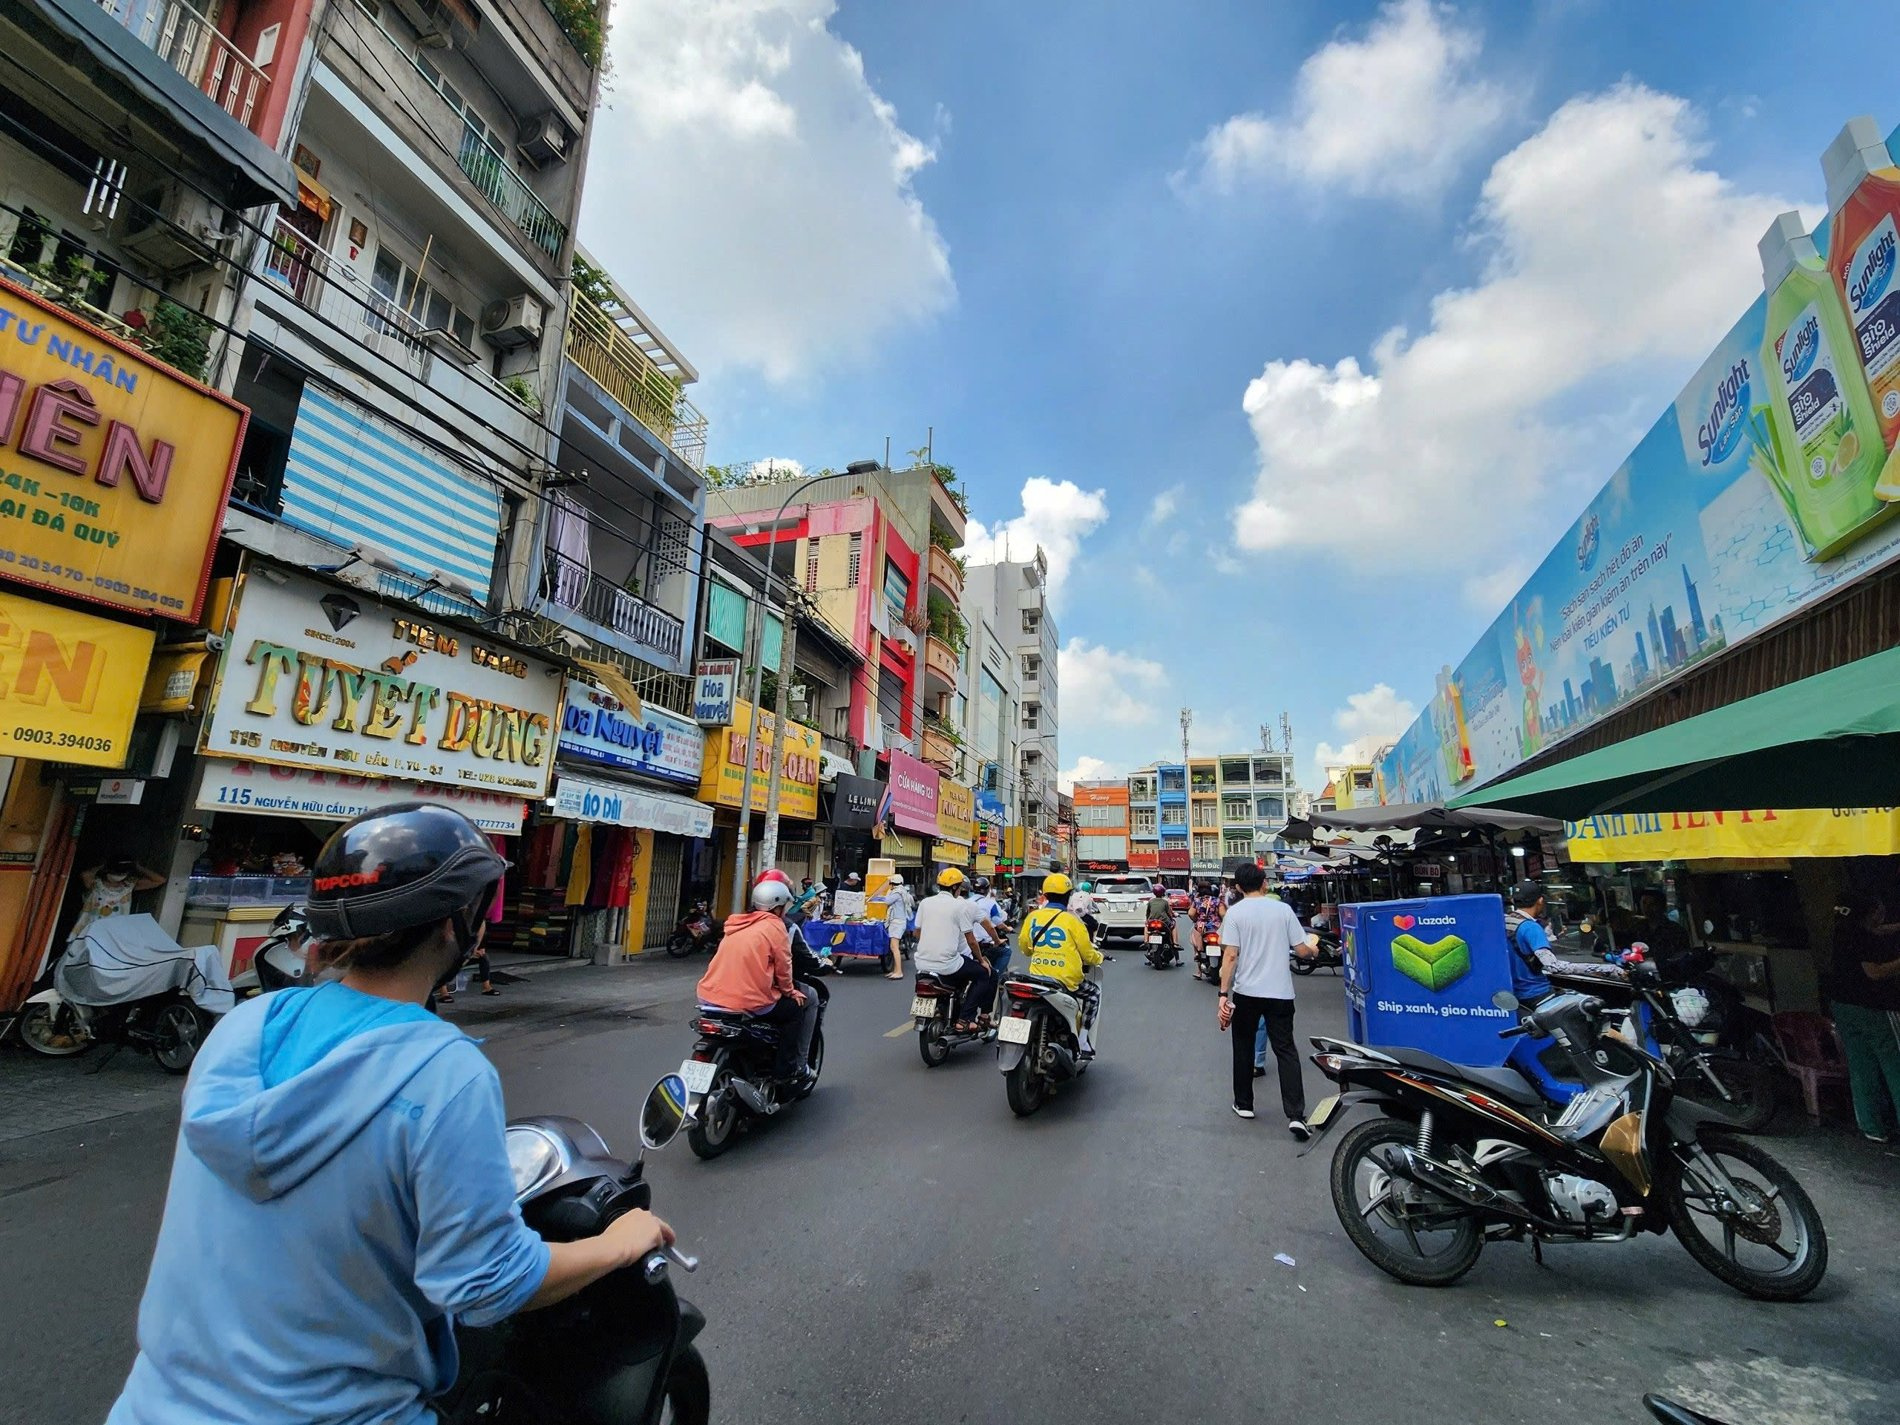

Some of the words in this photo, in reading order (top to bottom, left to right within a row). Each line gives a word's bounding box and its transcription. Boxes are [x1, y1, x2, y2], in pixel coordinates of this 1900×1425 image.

[1850, 230, 1896, 313] Sunlight
[0, 307, 46, 345] TƯ
[47, 334, 138, 394] NHÂN
[1783, 316, 1819, 384] Sunlight
[1865, 323, 1896, 359] Shield
[1698, 358, 1750, 467] Sunlight
[1796, 397, 1821, 425] Shield
[1720, 431, 1731, 452] Lau
[1730, 405, 1744, 428] Sàn
[32, 509, 65, 532] ĐÁ
[74, 523, 120, 549] QUÝ
[1606, 557, 1621, 579] hết
[1630, 557, 1650, 582] trên
[244, 640, 441, 745] TUYẾT
[701, 679, 724, 698] Hoa
[13, 727, 112, 752] 0903.394036
[229, 729, 262, 748] 115
[593, 709, 664, 762] Nguyệt
[216, 785, 252, 805] 115
[254, 795, 299, 811] NGUYỄN
[301, 800, 323, 812] HỮU
[582, 787, 600, 817] ÁO
[602, 792, 622, 820] DÀI
[860, 795, 877, 807] LINH
[1031, 918, 1067, 948] be
[1418, 915, 1456, 926] Lazada
[1378, 1001, 1403, 1014] Ship
[1405, 1003, 1439, 1016] xanh,
[1441, 1004, 1468, 1018] giao
[1470, 1005, 1510, 1018] nhanh
